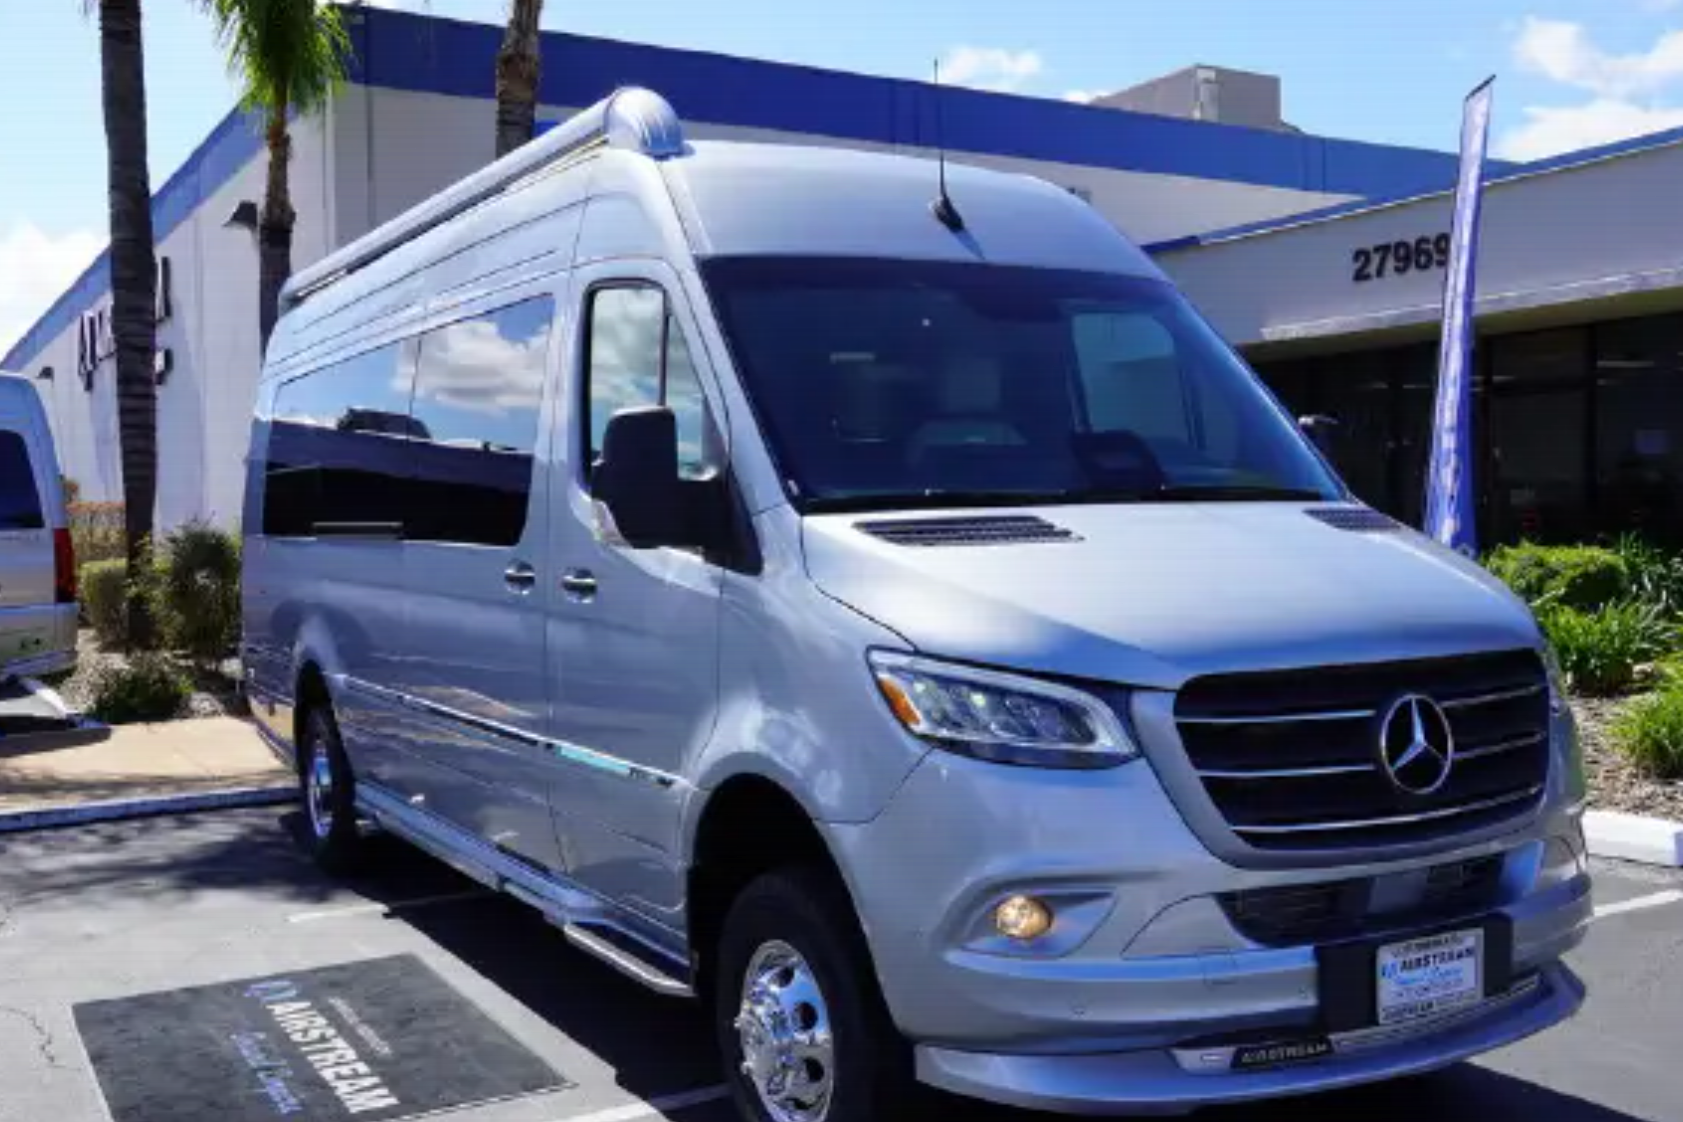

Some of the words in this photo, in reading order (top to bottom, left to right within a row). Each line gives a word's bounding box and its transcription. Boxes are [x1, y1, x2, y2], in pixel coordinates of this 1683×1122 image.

[1353, 232, 1450, 282] 27969
[265, 1001, 399, 1113] AIRSTREAM
[1241, 1043, 1327, 1063] AIRSTREAM
